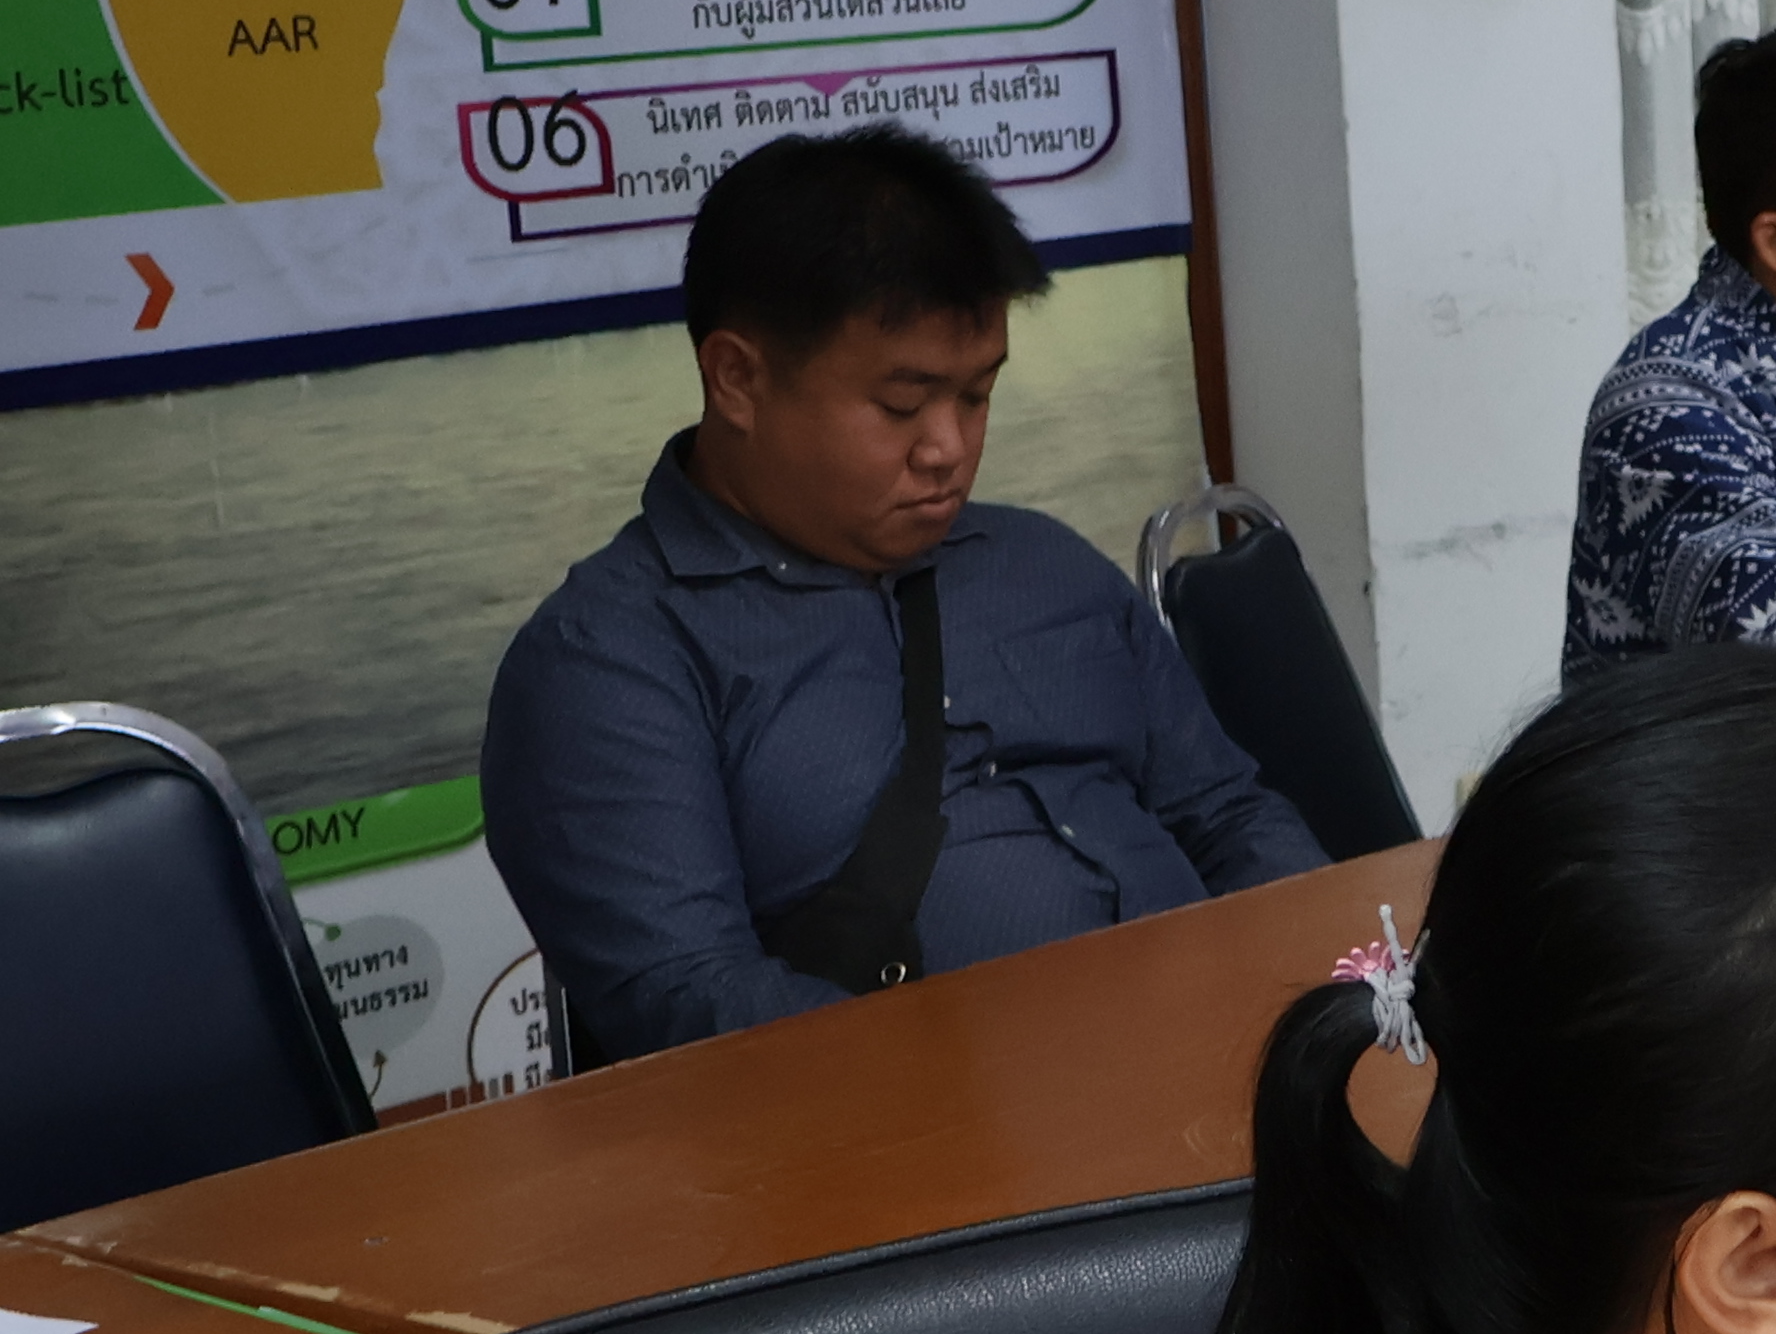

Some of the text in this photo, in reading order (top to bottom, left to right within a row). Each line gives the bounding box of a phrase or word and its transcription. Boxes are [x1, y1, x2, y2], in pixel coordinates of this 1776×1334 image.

[227, 14, 319, 58] AAR
[646, 63, 1061, 135] นิเทศ ติดตาม สนับสนุน ส่งเสริม
[487, 91, 588, 171] 06
[944, 120, 1095, 162] ามเป้าหมาย
